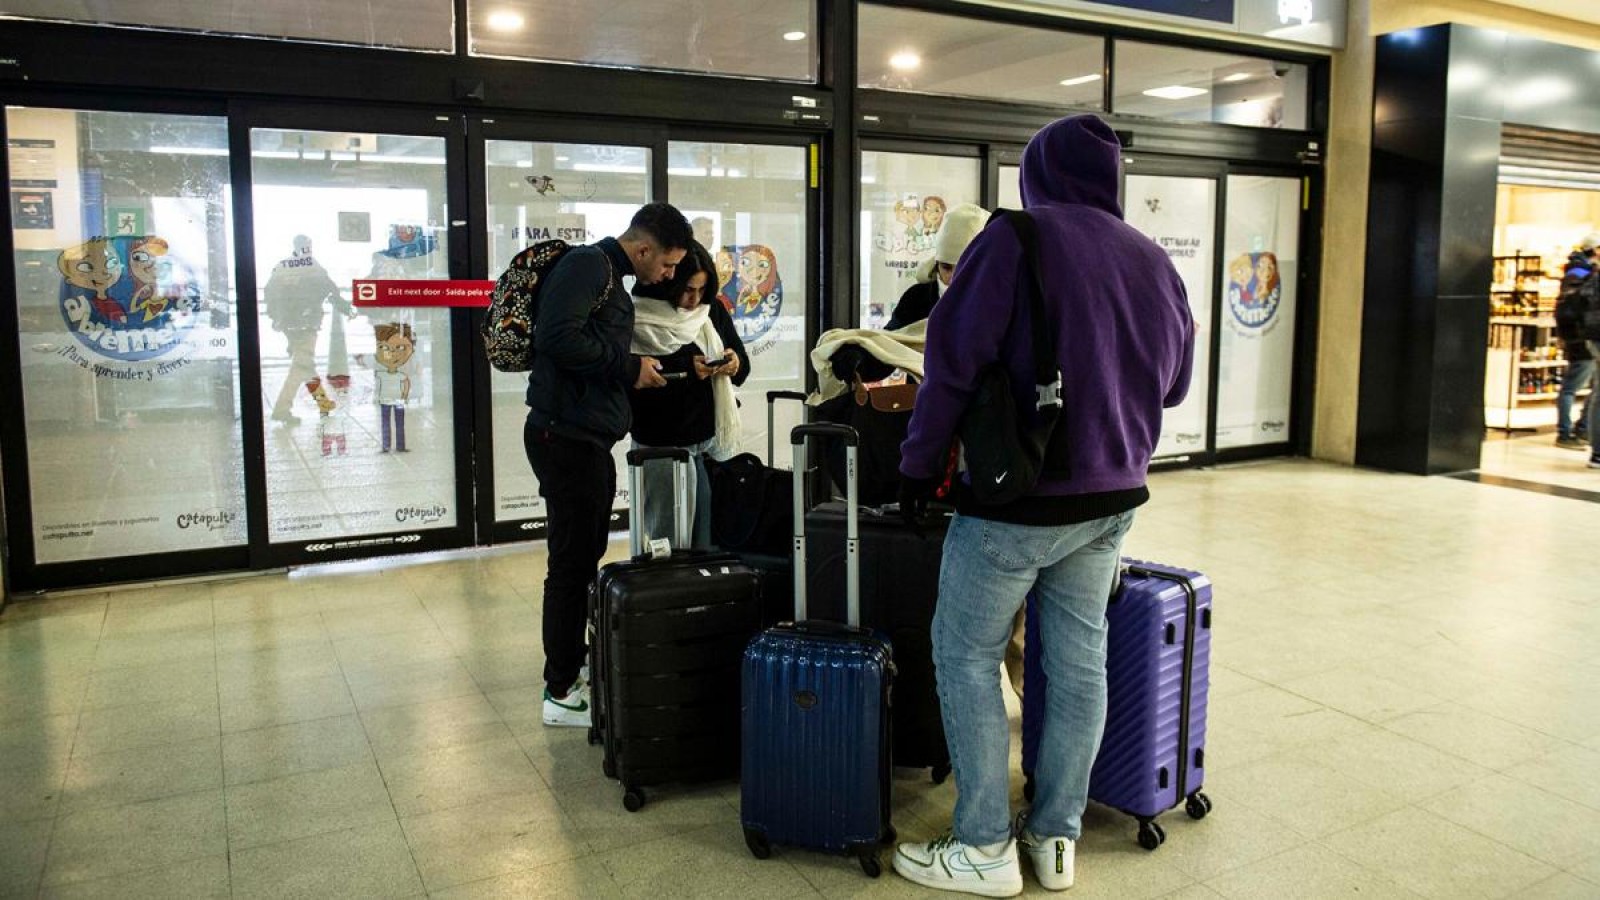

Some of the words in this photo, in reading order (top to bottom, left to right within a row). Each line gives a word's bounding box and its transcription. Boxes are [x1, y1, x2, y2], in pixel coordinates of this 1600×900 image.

[388, 287, 402, 296] Exit
[423, 287, 441, 296] door
[467, 287, 484, 298] pela
[147, 369, 153, 381] y
[177, 511, 236, 529] Catapulta
[396, 505, 447, 522] Catapulta
